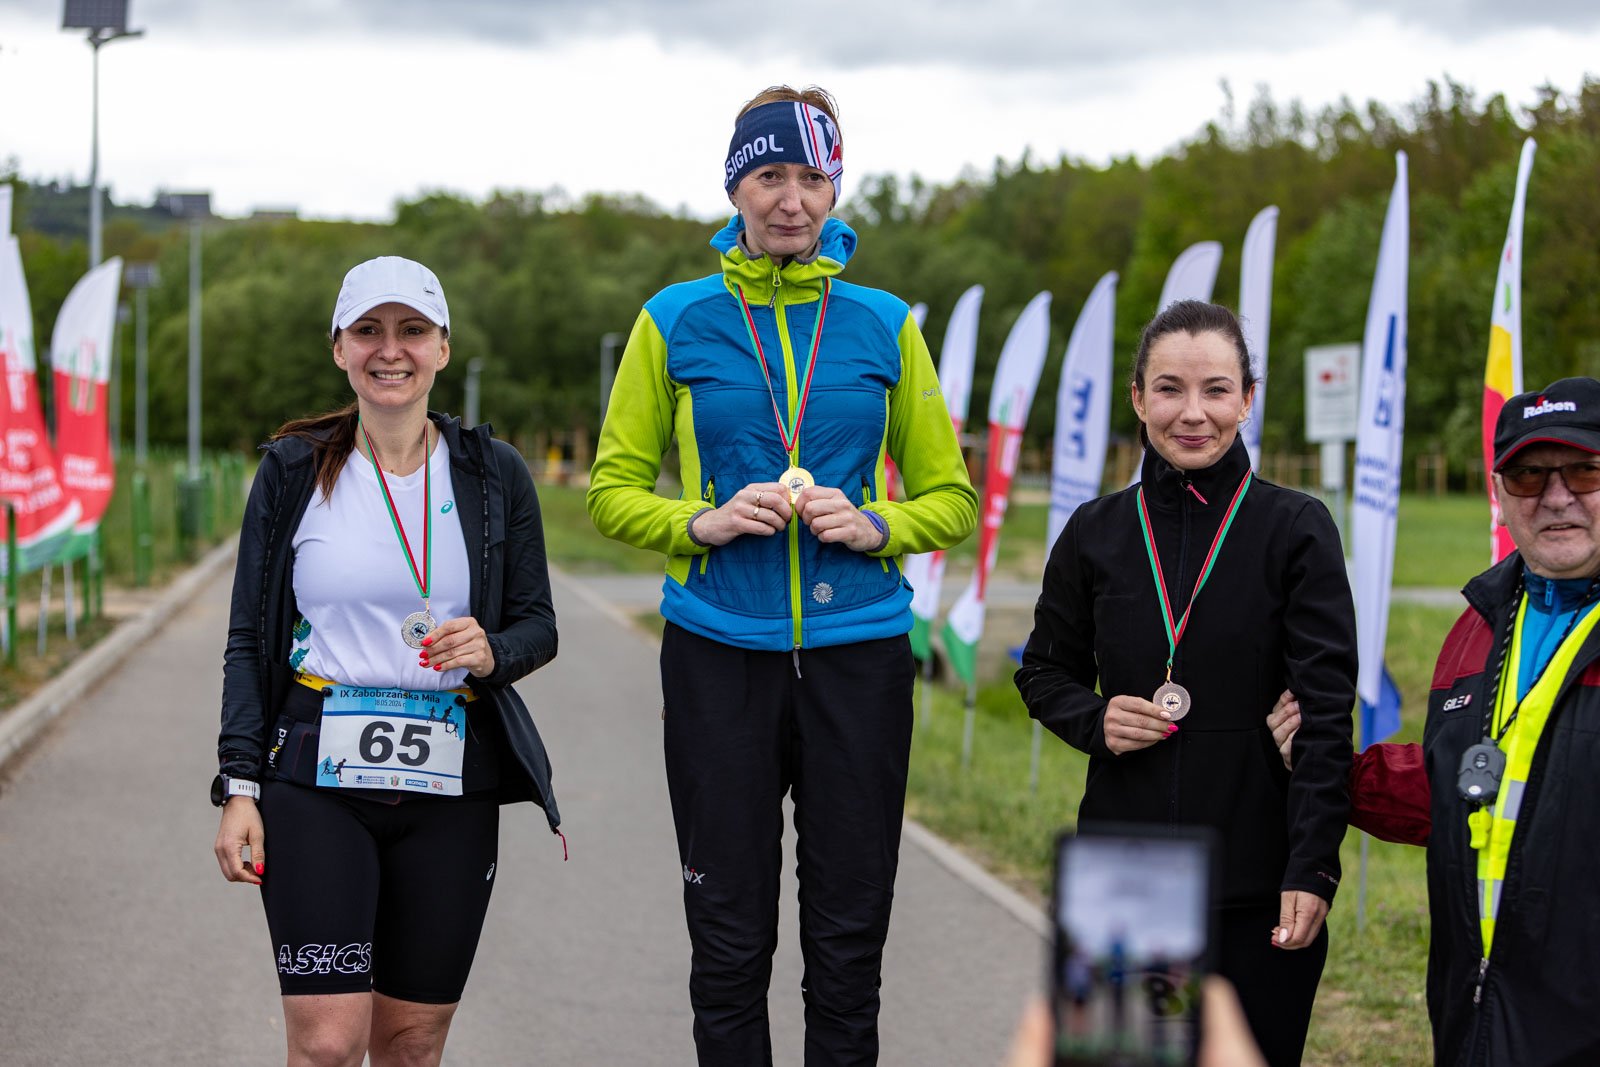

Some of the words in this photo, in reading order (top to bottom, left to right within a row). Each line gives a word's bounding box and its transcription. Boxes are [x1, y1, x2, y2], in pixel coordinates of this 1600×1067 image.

[340, 690, 350, 698] IX
[352, 689, 419, 701] Zabobrzańska
[421, 694, 440, 704] Mila
[358, 720, 432, 767] 65
[278, 942, 372, 975] ASICS
